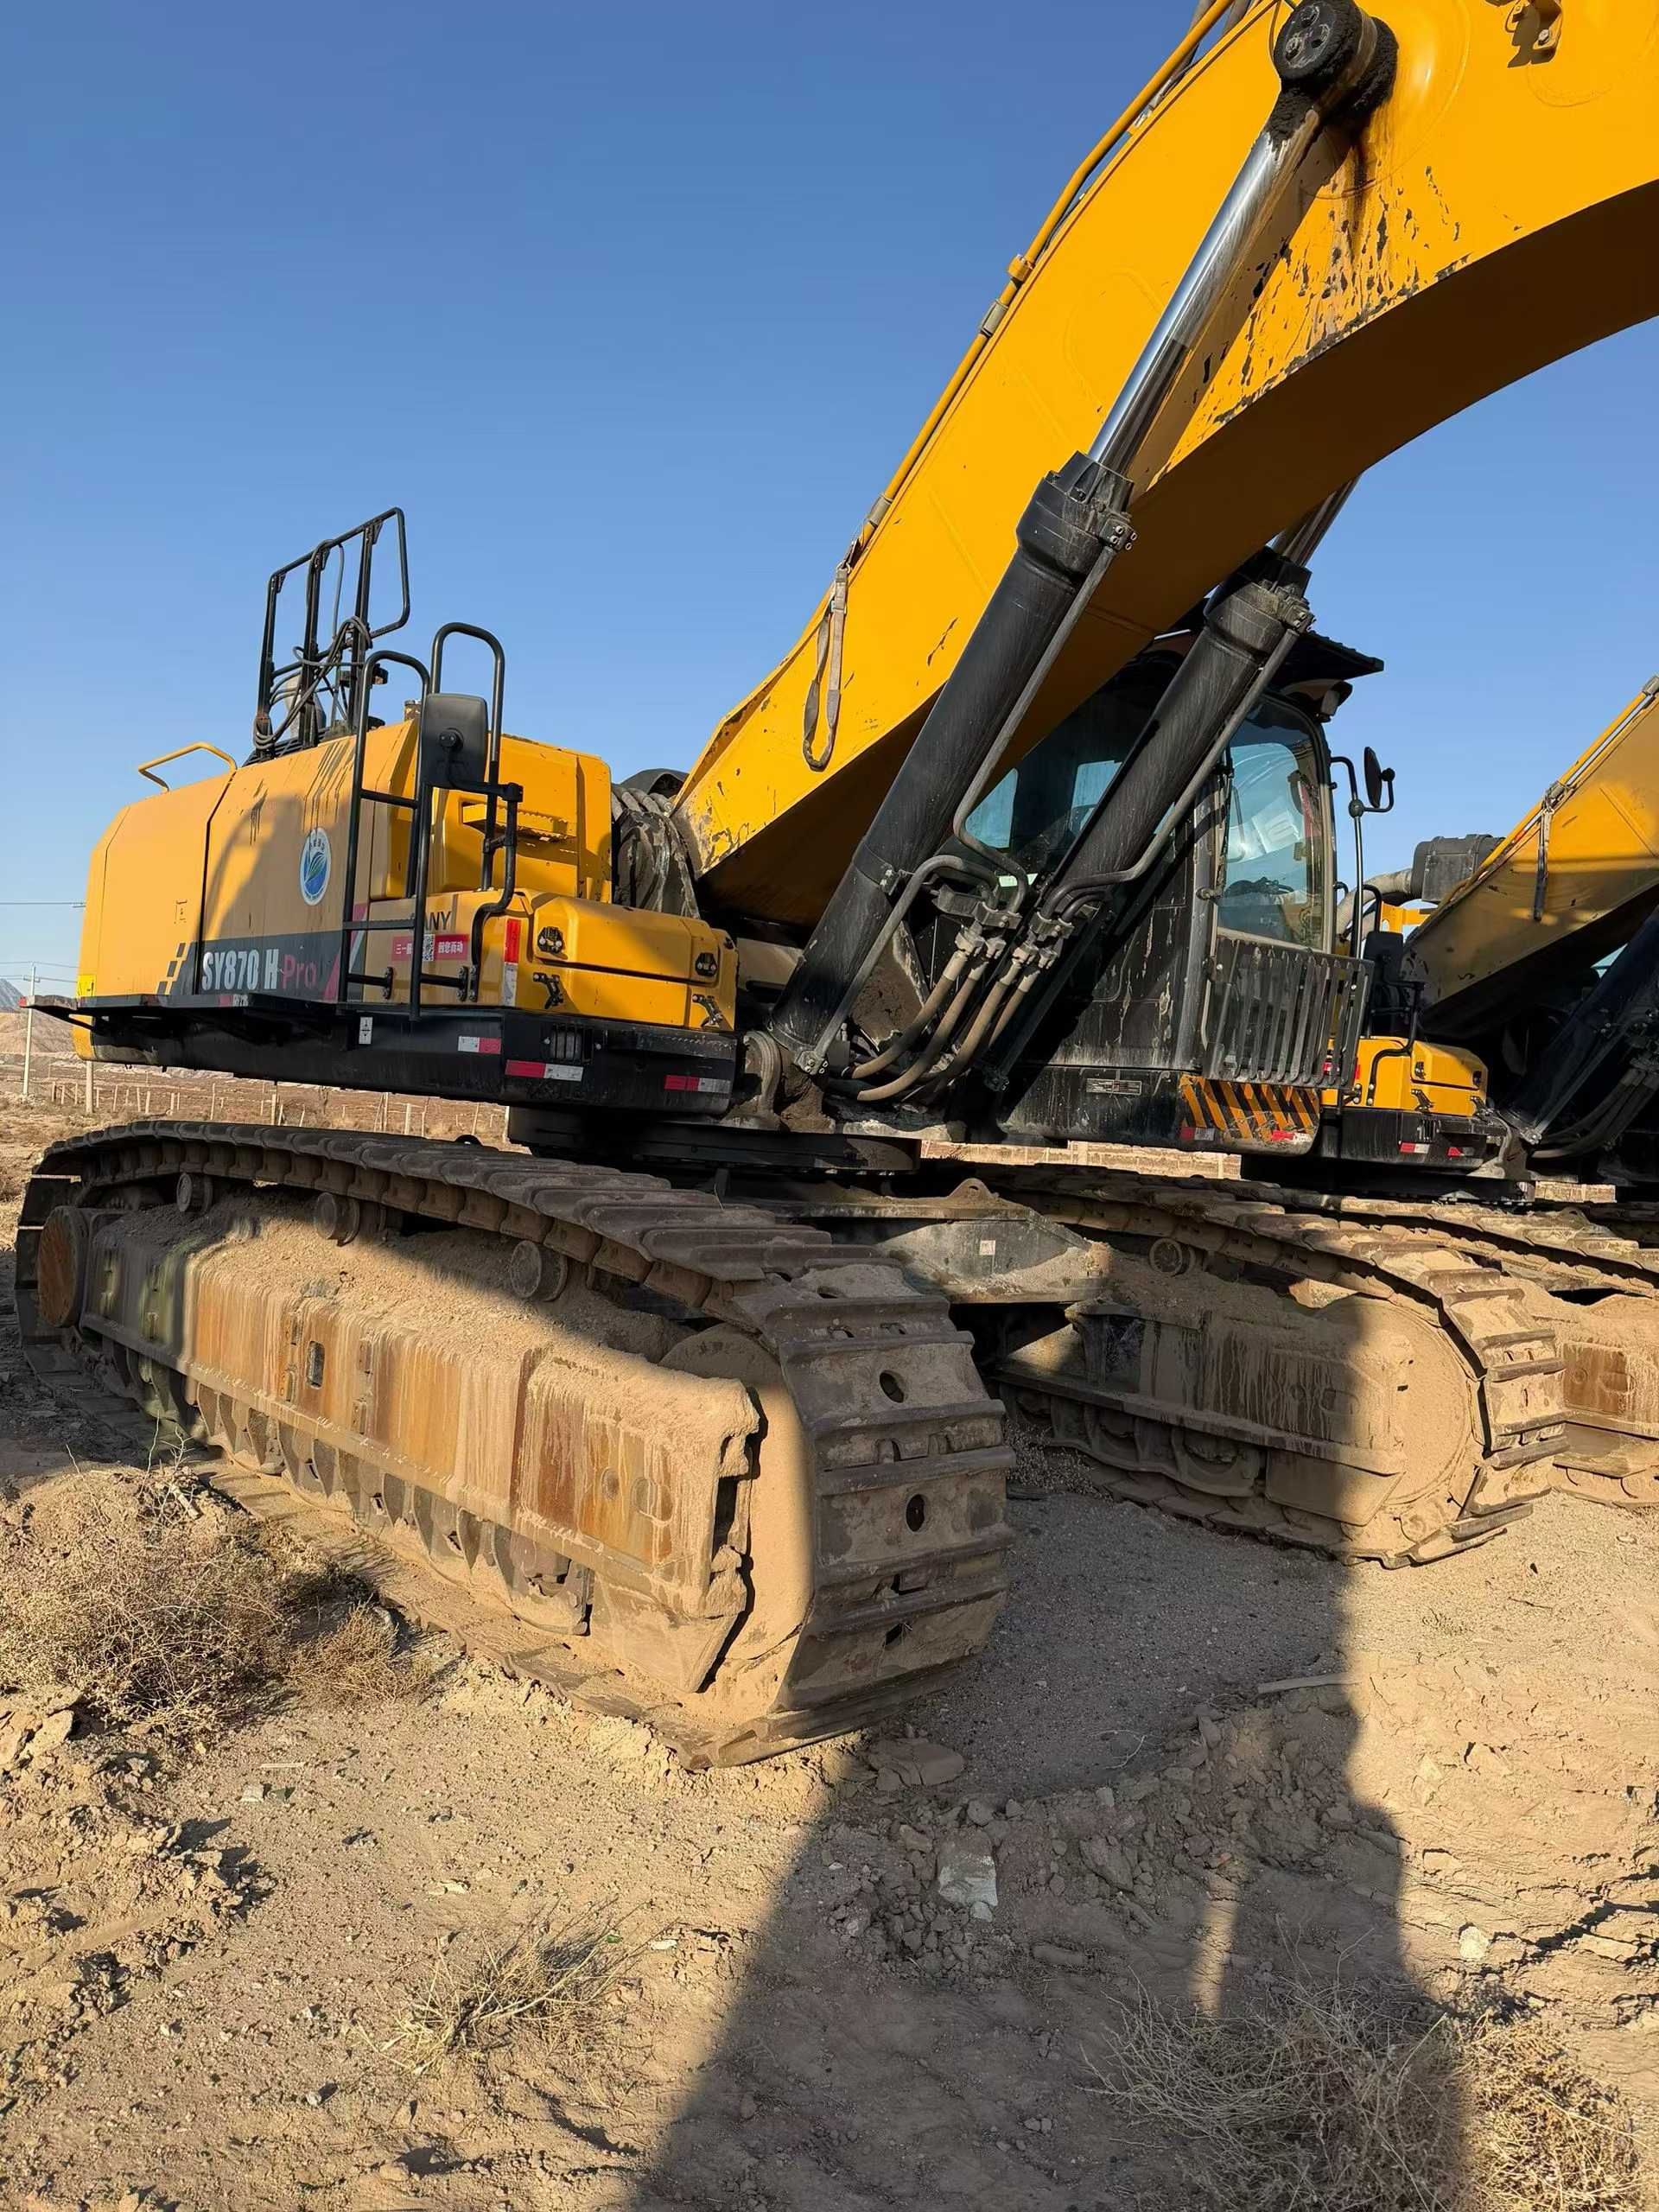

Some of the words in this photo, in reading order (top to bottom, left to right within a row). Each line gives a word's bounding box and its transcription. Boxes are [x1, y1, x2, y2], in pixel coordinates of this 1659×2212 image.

[201, 949, 260, 991] SY870
[264, 948, 280, 990] H
[282, 953, 317, 989] Pro
